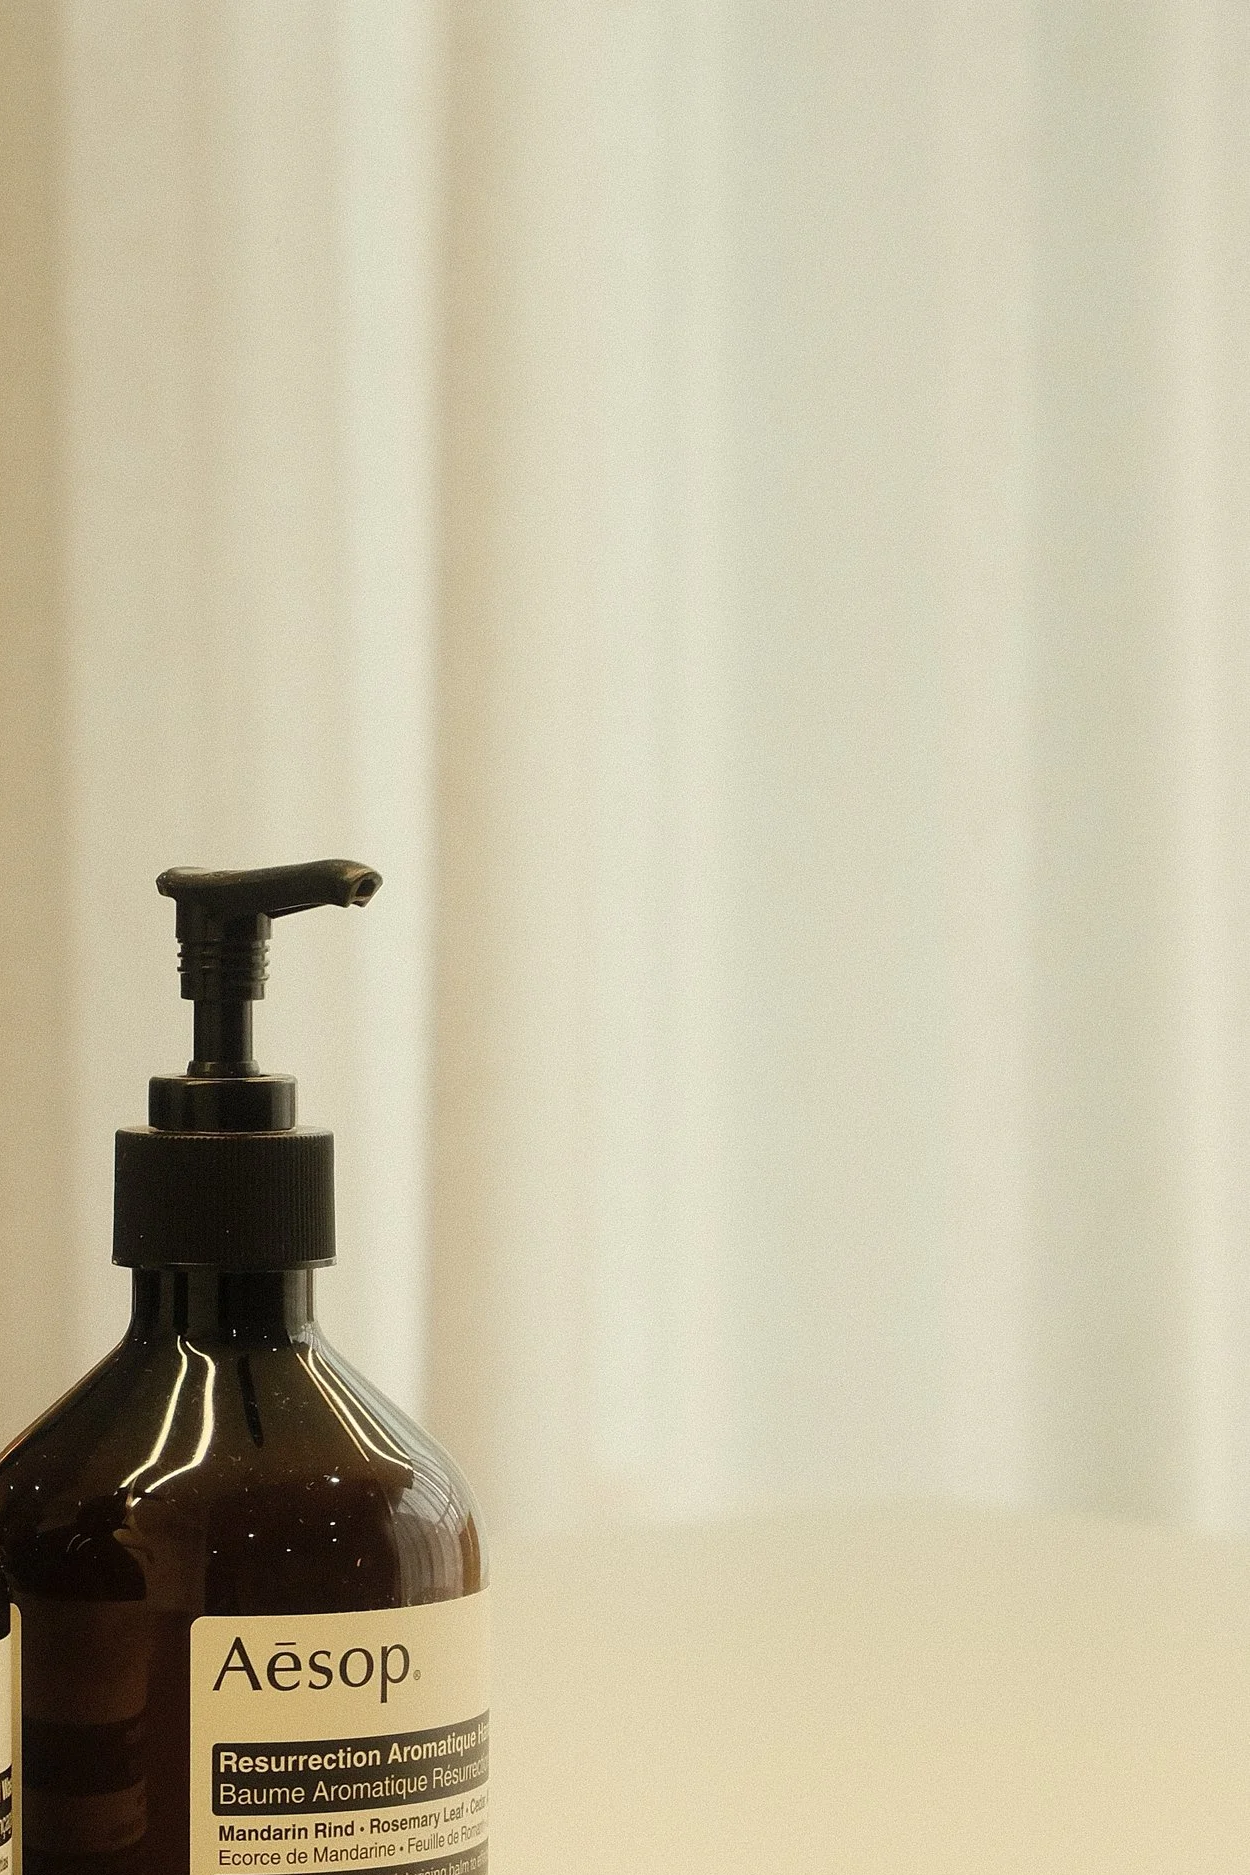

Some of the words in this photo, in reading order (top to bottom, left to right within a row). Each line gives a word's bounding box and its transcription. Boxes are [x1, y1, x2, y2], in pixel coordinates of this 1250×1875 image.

[219, 1750, 380, 1773] Resurrection
[387, 1730, 476, 1764] Aromatique
[219, 1782, 305, 1805] Baume
[312, 1774, 428, 1802] Aromatique
[218, 1823, 308, 1842] Mandarin
[315, 1820, 355, 1838] Rind
[370, 1811, 441, 1834] Rosemary
[444, 1804, 464, 1823] Leaf
[219, 1850, 281, 1867] Ecorce
[287, 1848, 308, 1865] de
[313, 1844, 396, 1863] Mandarine
[408, 1833, 444, 1854] Feuille
[448, 1829, 459, 1844] de
